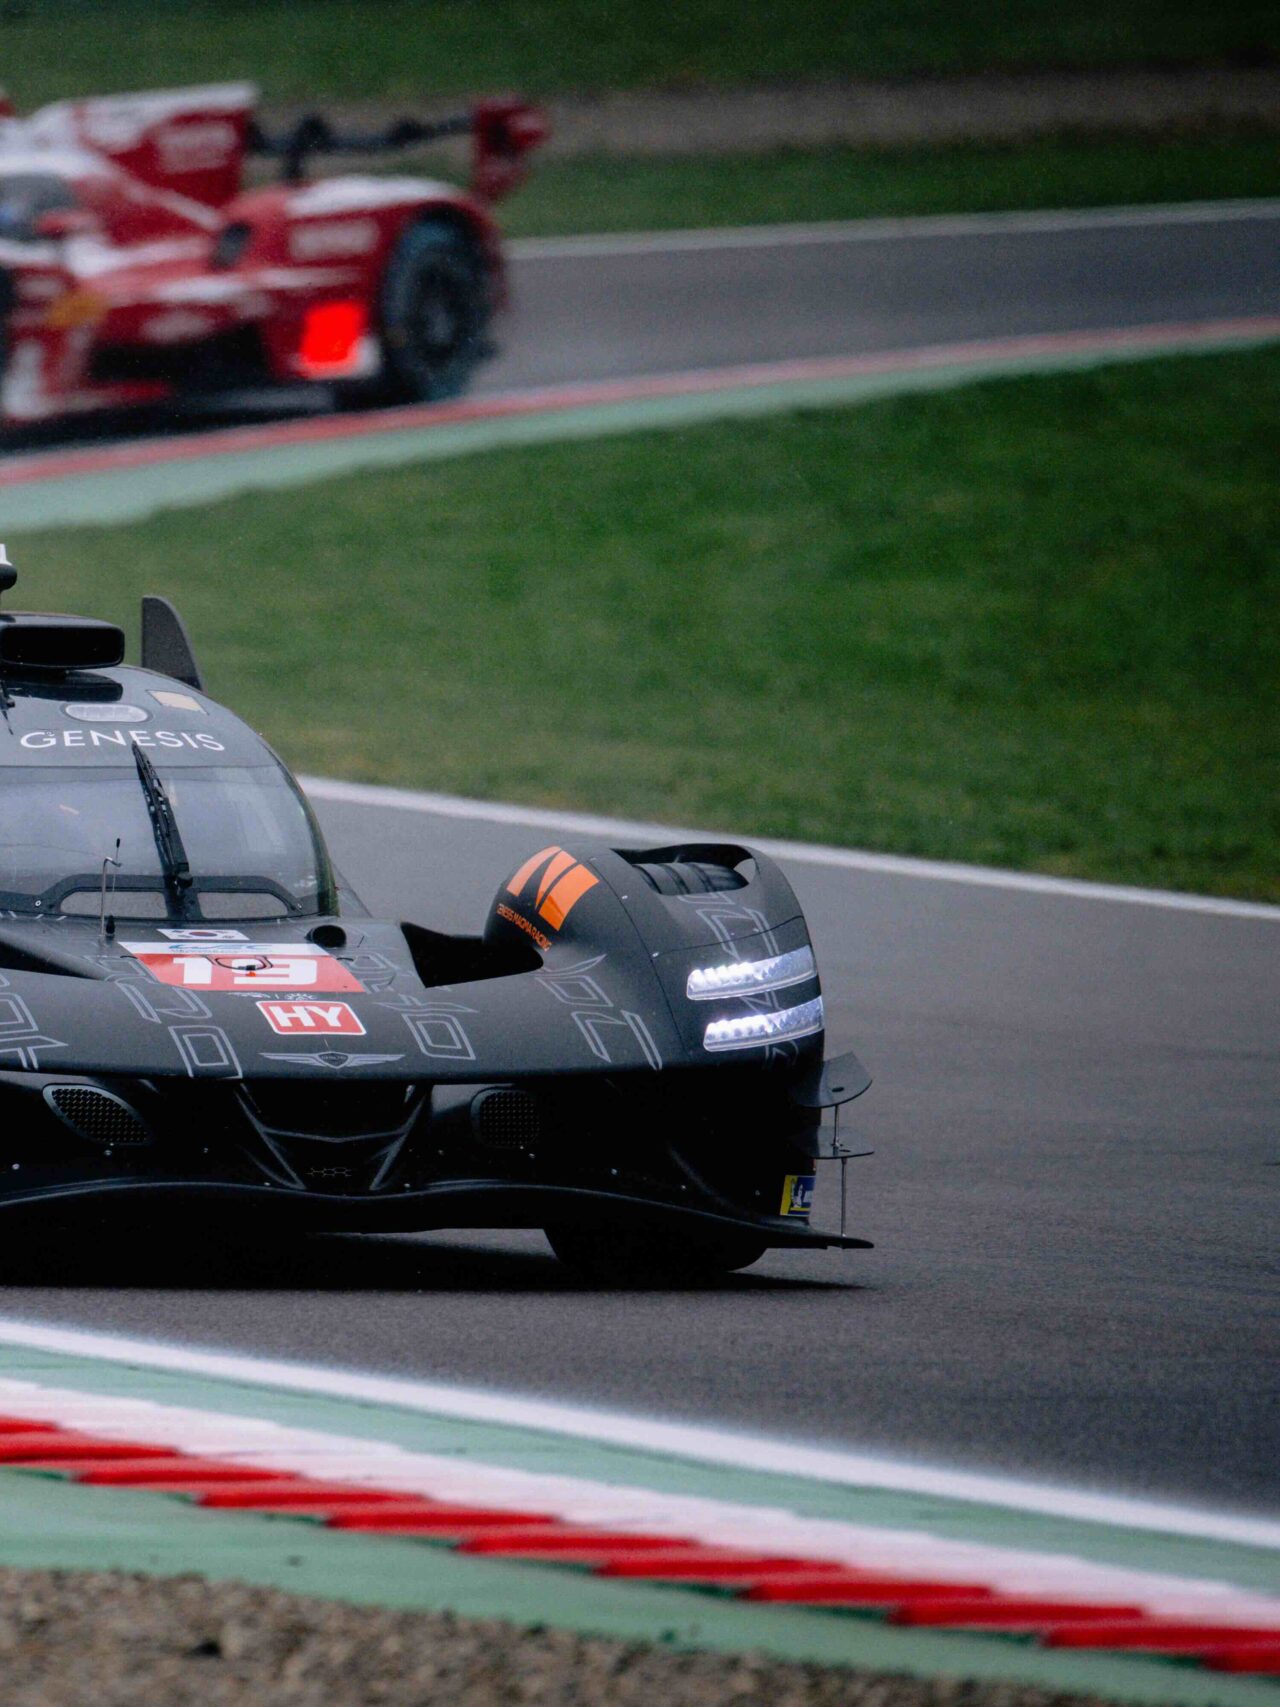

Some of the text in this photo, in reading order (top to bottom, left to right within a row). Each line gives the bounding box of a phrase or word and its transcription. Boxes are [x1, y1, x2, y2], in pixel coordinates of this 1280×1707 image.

[20, 730, 225, 751] GENESIS
[172, 957, 318, 985] 19
[269, 1005, 343, 1027] HY
